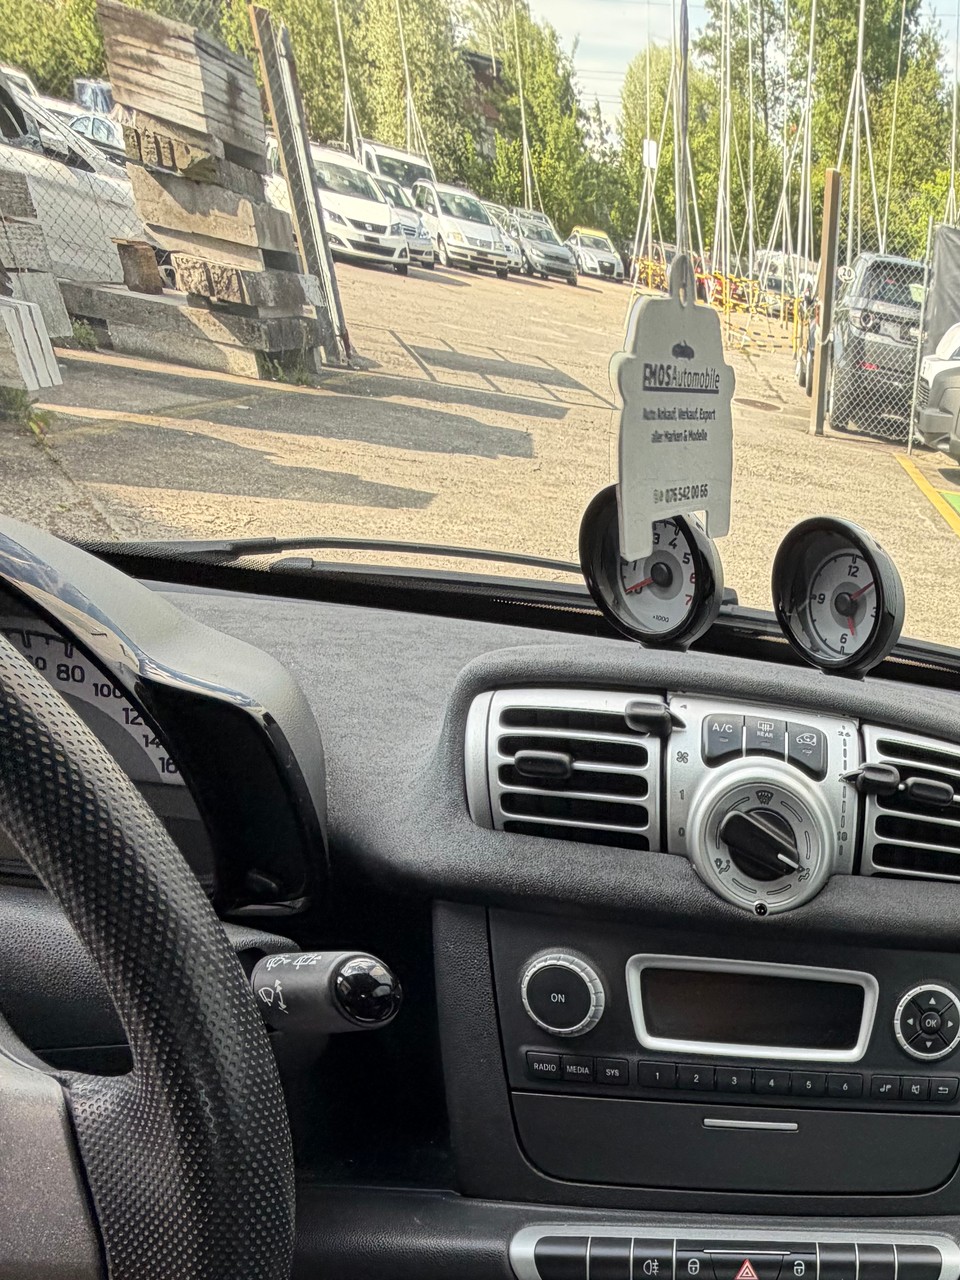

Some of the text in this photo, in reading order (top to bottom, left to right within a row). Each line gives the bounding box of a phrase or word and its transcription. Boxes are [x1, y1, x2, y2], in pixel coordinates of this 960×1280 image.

[690, 484, 700, 500] 00
[668, 537, 678, 549] 4
[682, 552, 692, 565] 5
[631, 560, 638, 571] 1
[847, 564, 860, 578] 12
[685, 594, 693, 606] 7
[817, 592, 826, 605] 9
[839, 632, 848, 645] 6
[56, 663, 85, 683] 80
[92, 682, 124, 698] 100
[122, 707, 143, 726] 12
[712, 722, 733, 733] A/C
[142, 734, 161, 749] 14
[158, 756, 179, 774] 16
[678, 826, 686, 838] 0
[550, 993, 565, 1003] ON
[925, 1018, 937, 1028] OK
[533, 1062, 557, 1072] RADIO
[566, 1065, 590, 1074] MEDIA
[605, 1068, 620, 1077] SYS
[693, 1074, 700, 1083] 2
[731, 1076, 738, 1085] 3
[768, 1078, 775, 1087] 4
[806, 1081, 812, 1089] 5
[842, 1082, 849, 1091] 6
